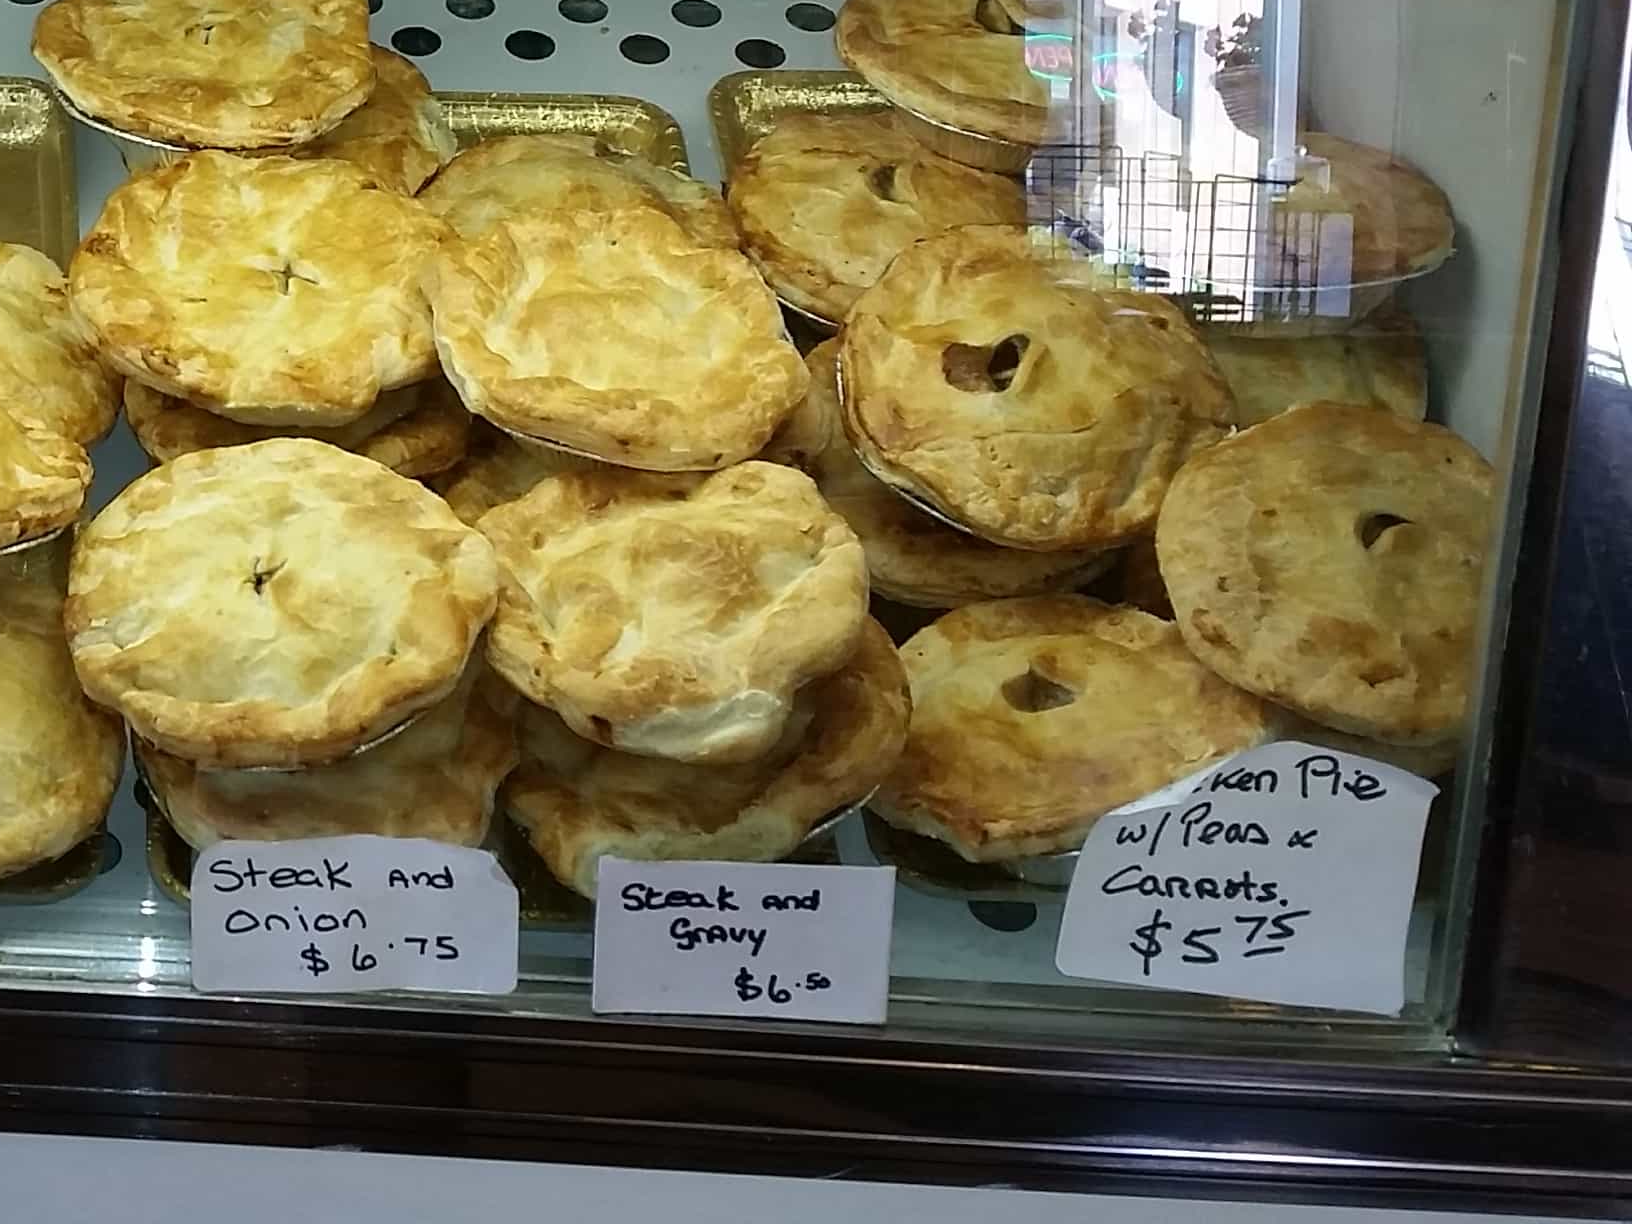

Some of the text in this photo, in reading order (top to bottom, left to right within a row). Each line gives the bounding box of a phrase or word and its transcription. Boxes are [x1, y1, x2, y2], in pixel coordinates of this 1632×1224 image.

[1295, 755, 1386, 800] Pie
[1180, 802, 1270, 848] Peas
[209, 858, 352, 893] Steak
[621, 884, 820, 912] Steak and
